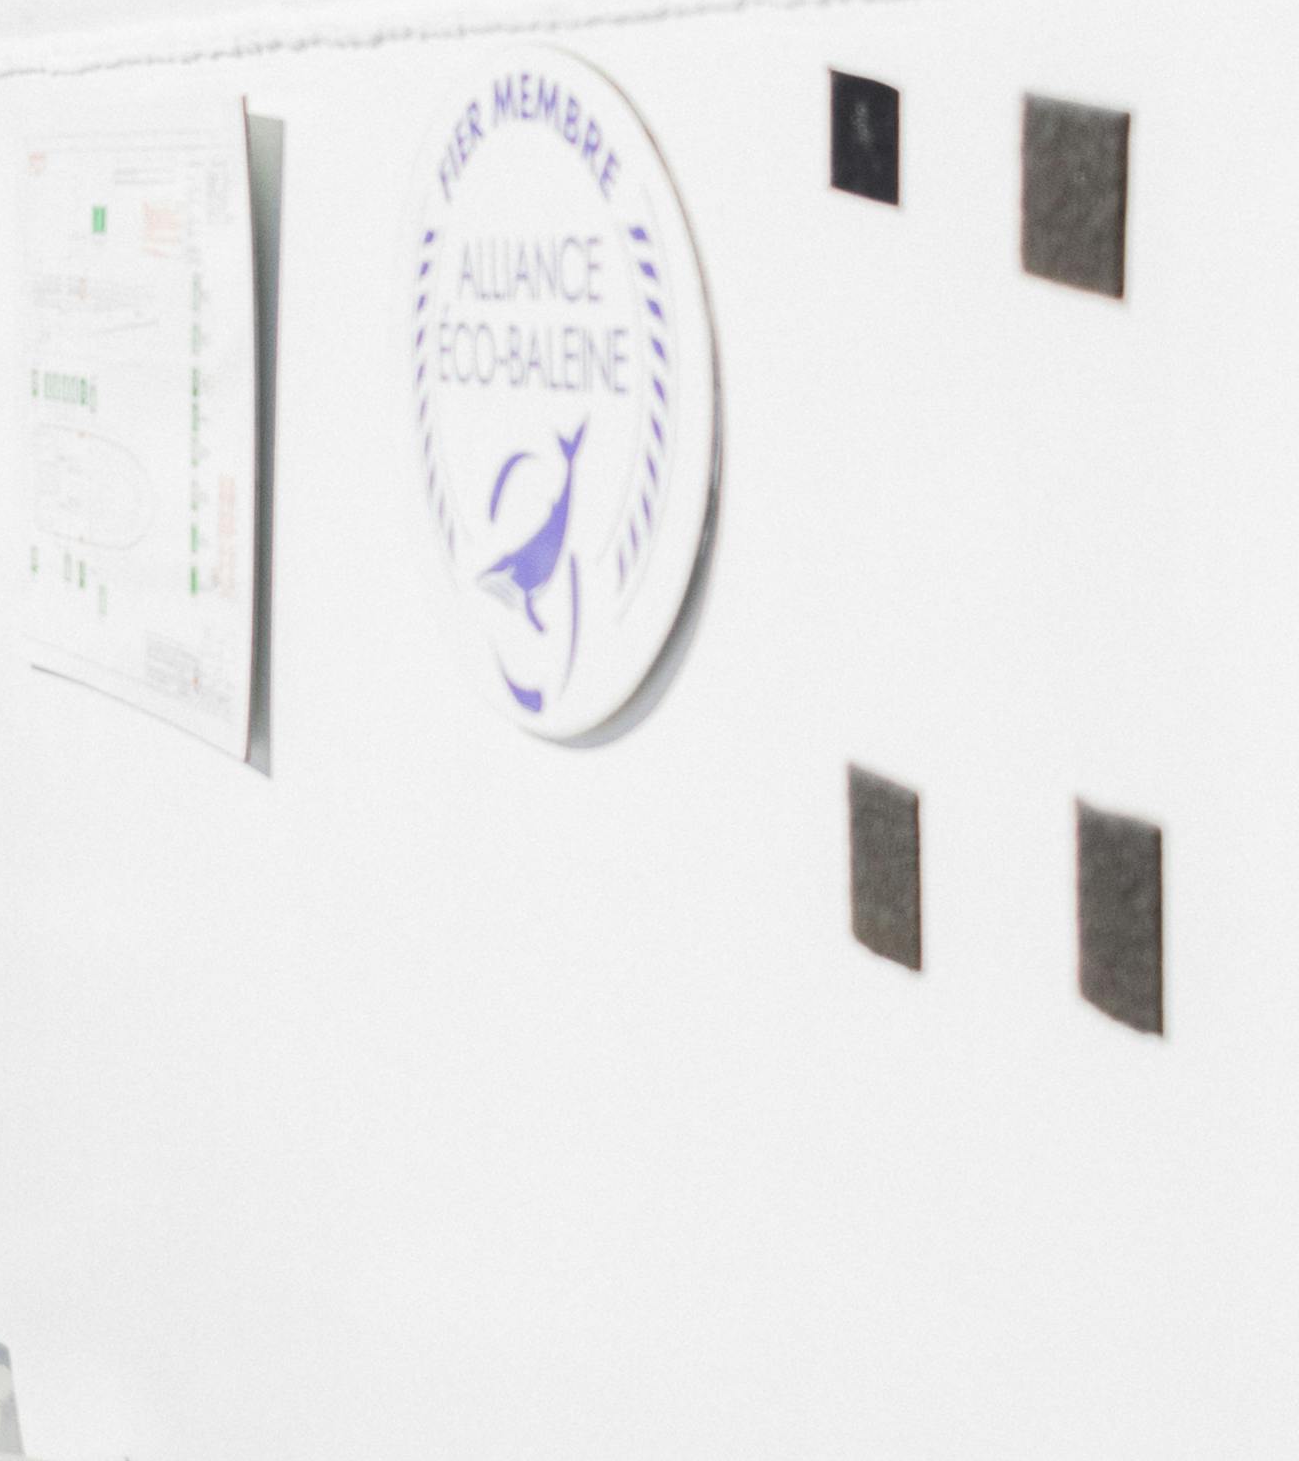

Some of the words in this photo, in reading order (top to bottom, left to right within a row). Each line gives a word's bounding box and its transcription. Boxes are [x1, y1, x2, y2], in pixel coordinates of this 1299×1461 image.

[438, 100, 485, 204] FIER
[492, 73, 621, 203] MEMBRE
[458, 234, 605, 302] ALLIANCE
[439, 304, 629, 394] ÉCO-BALEINE
